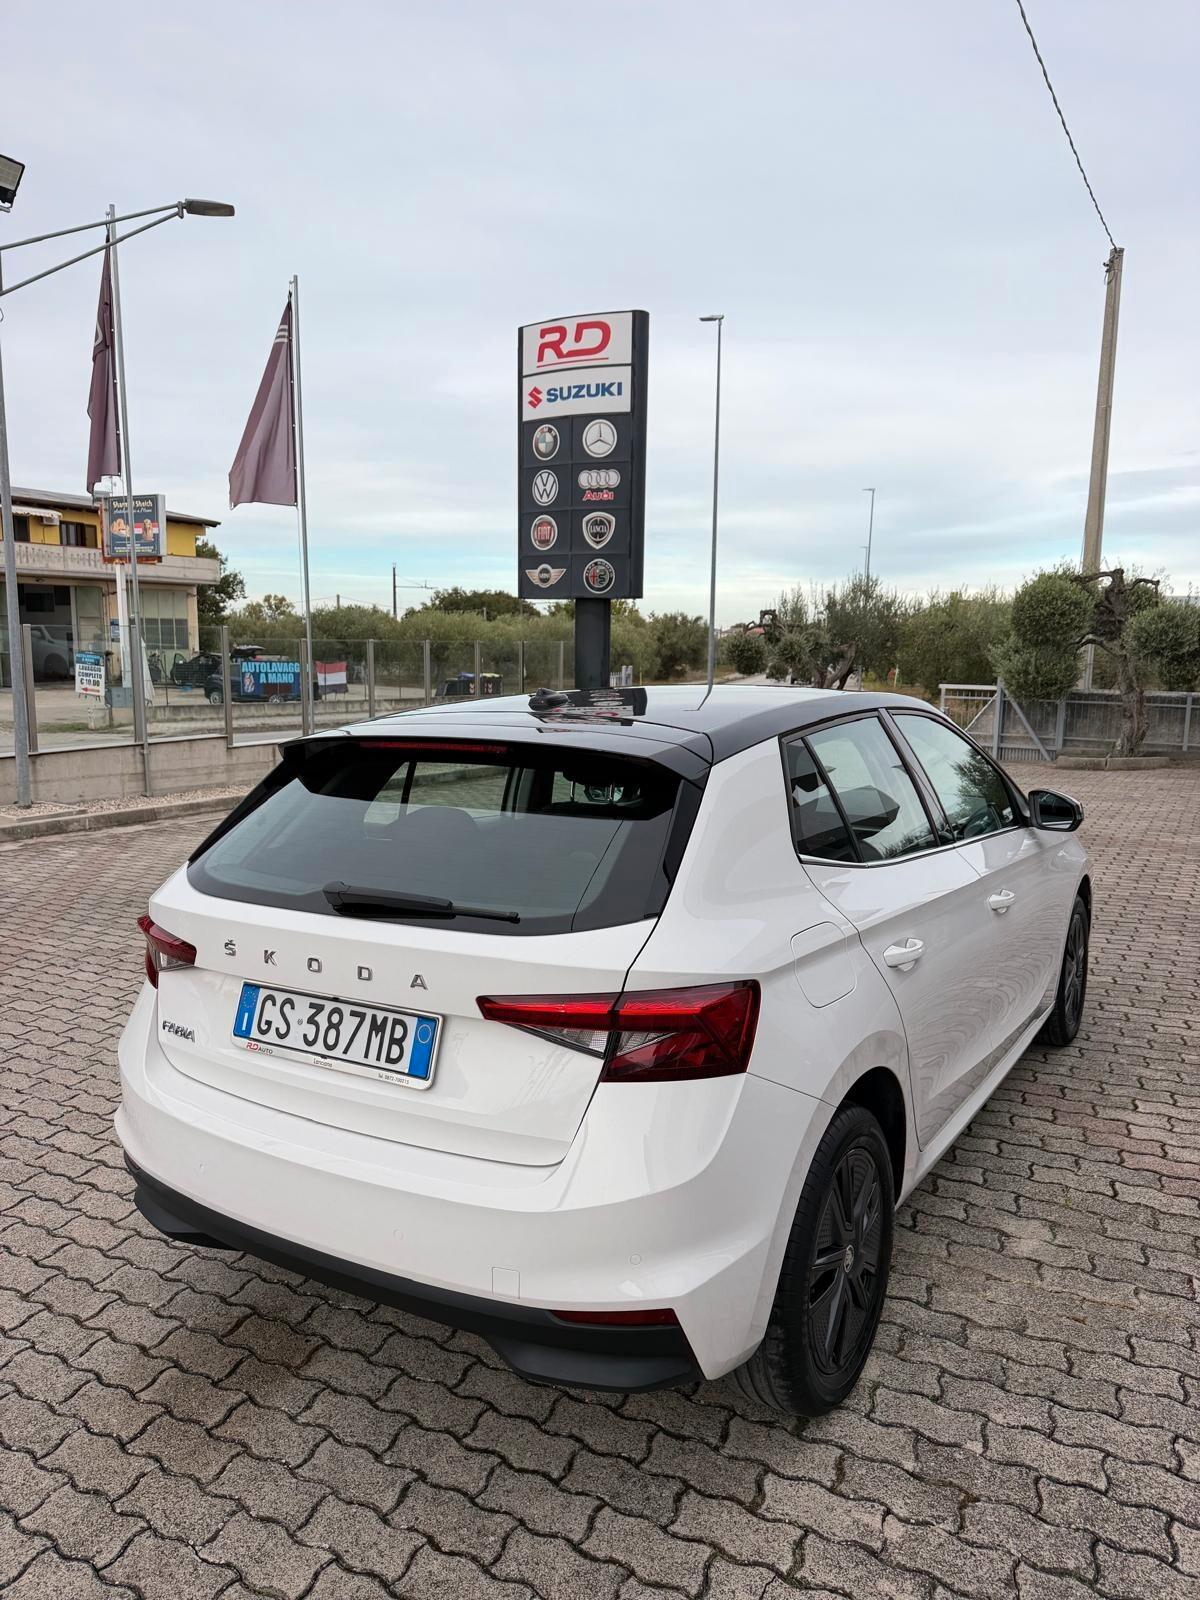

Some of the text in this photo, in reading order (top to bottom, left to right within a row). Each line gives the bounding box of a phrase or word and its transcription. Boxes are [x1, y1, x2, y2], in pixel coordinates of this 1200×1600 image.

[537, 320, 611, 363] RD
[546, 382, 622, 403] SUZUKI
[582, 489, 614, 501] Audi
[259, 672, 295, 684] A MANO
[224, 939, 429, 991] ŠKODA
